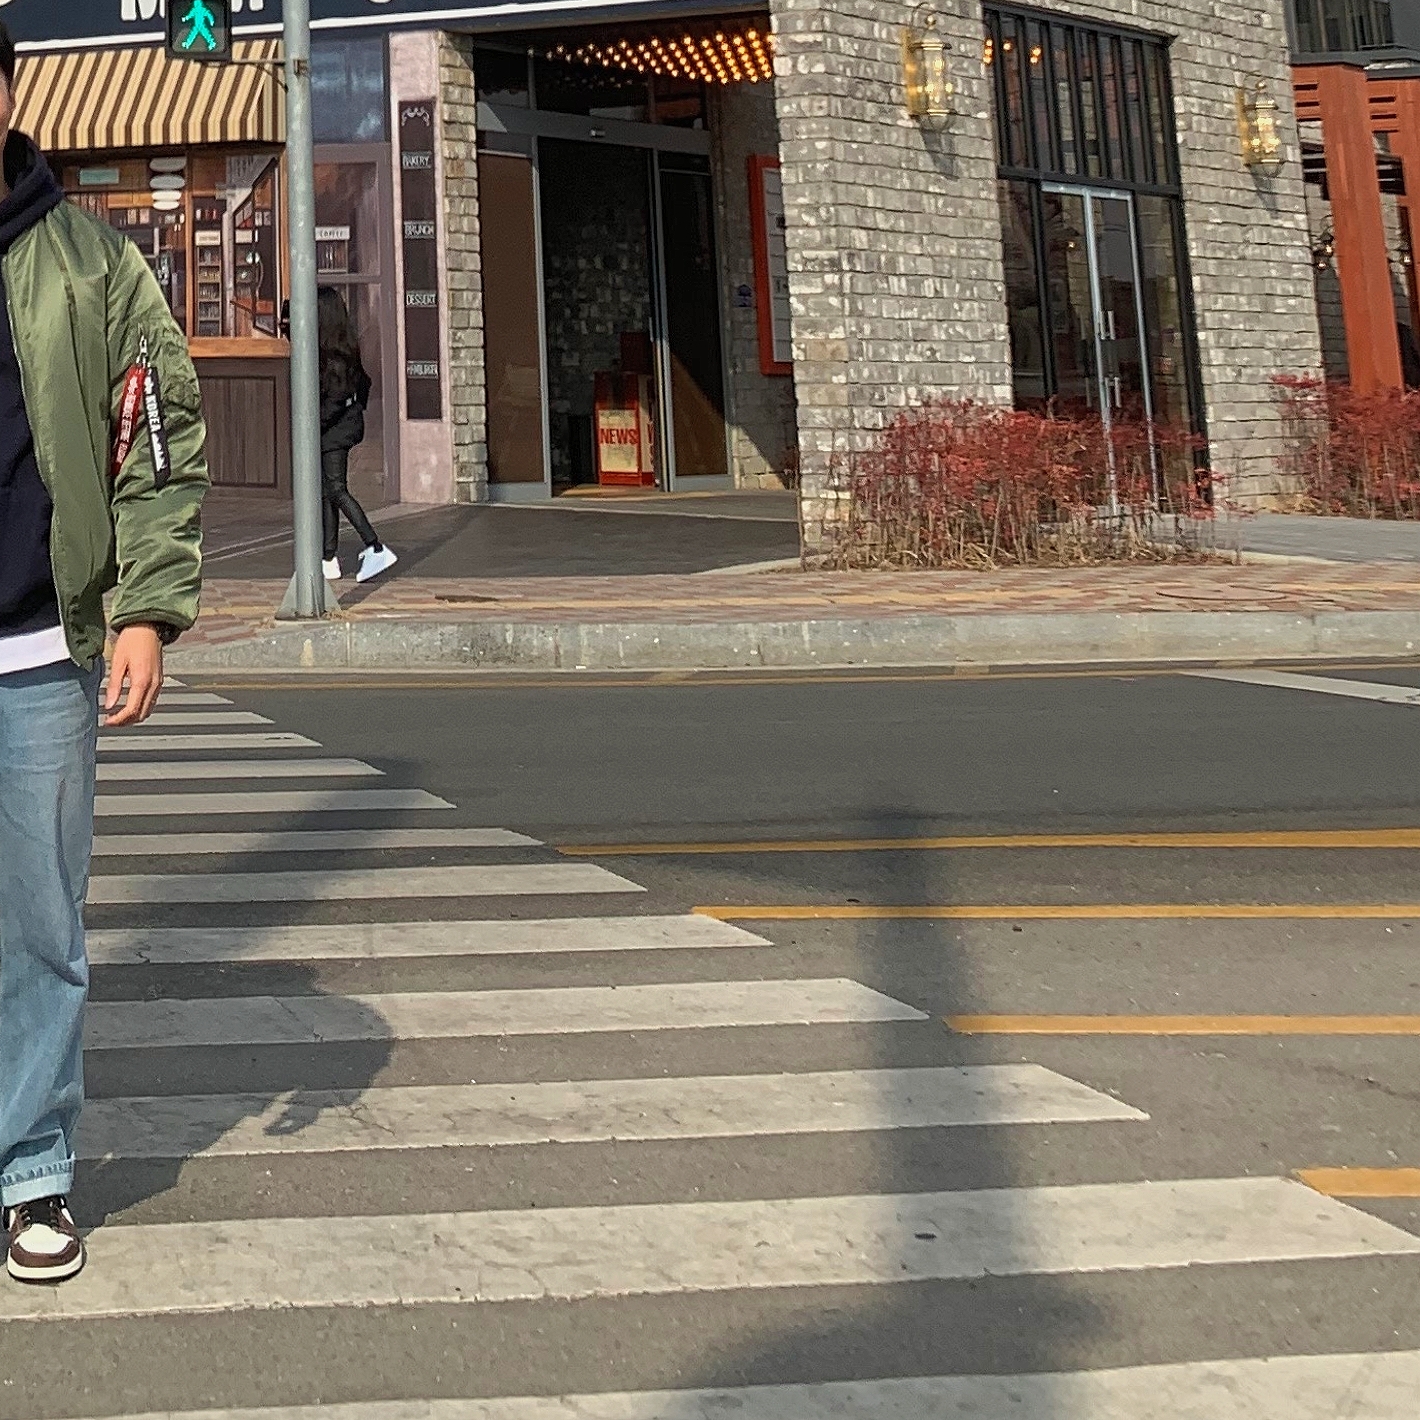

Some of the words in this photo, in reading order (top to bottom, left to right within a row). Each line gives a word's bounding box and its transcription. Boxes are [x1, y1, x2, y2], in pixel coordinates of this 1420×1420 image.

[402, 155, 430, 167] BAKERY
[404, 223, 435, 236] BRUNCH
[406, 293, 436, 305] DESSERT
[145, 394, 162, 432] KOREA
[600, 428, 639, 444] NEWS
